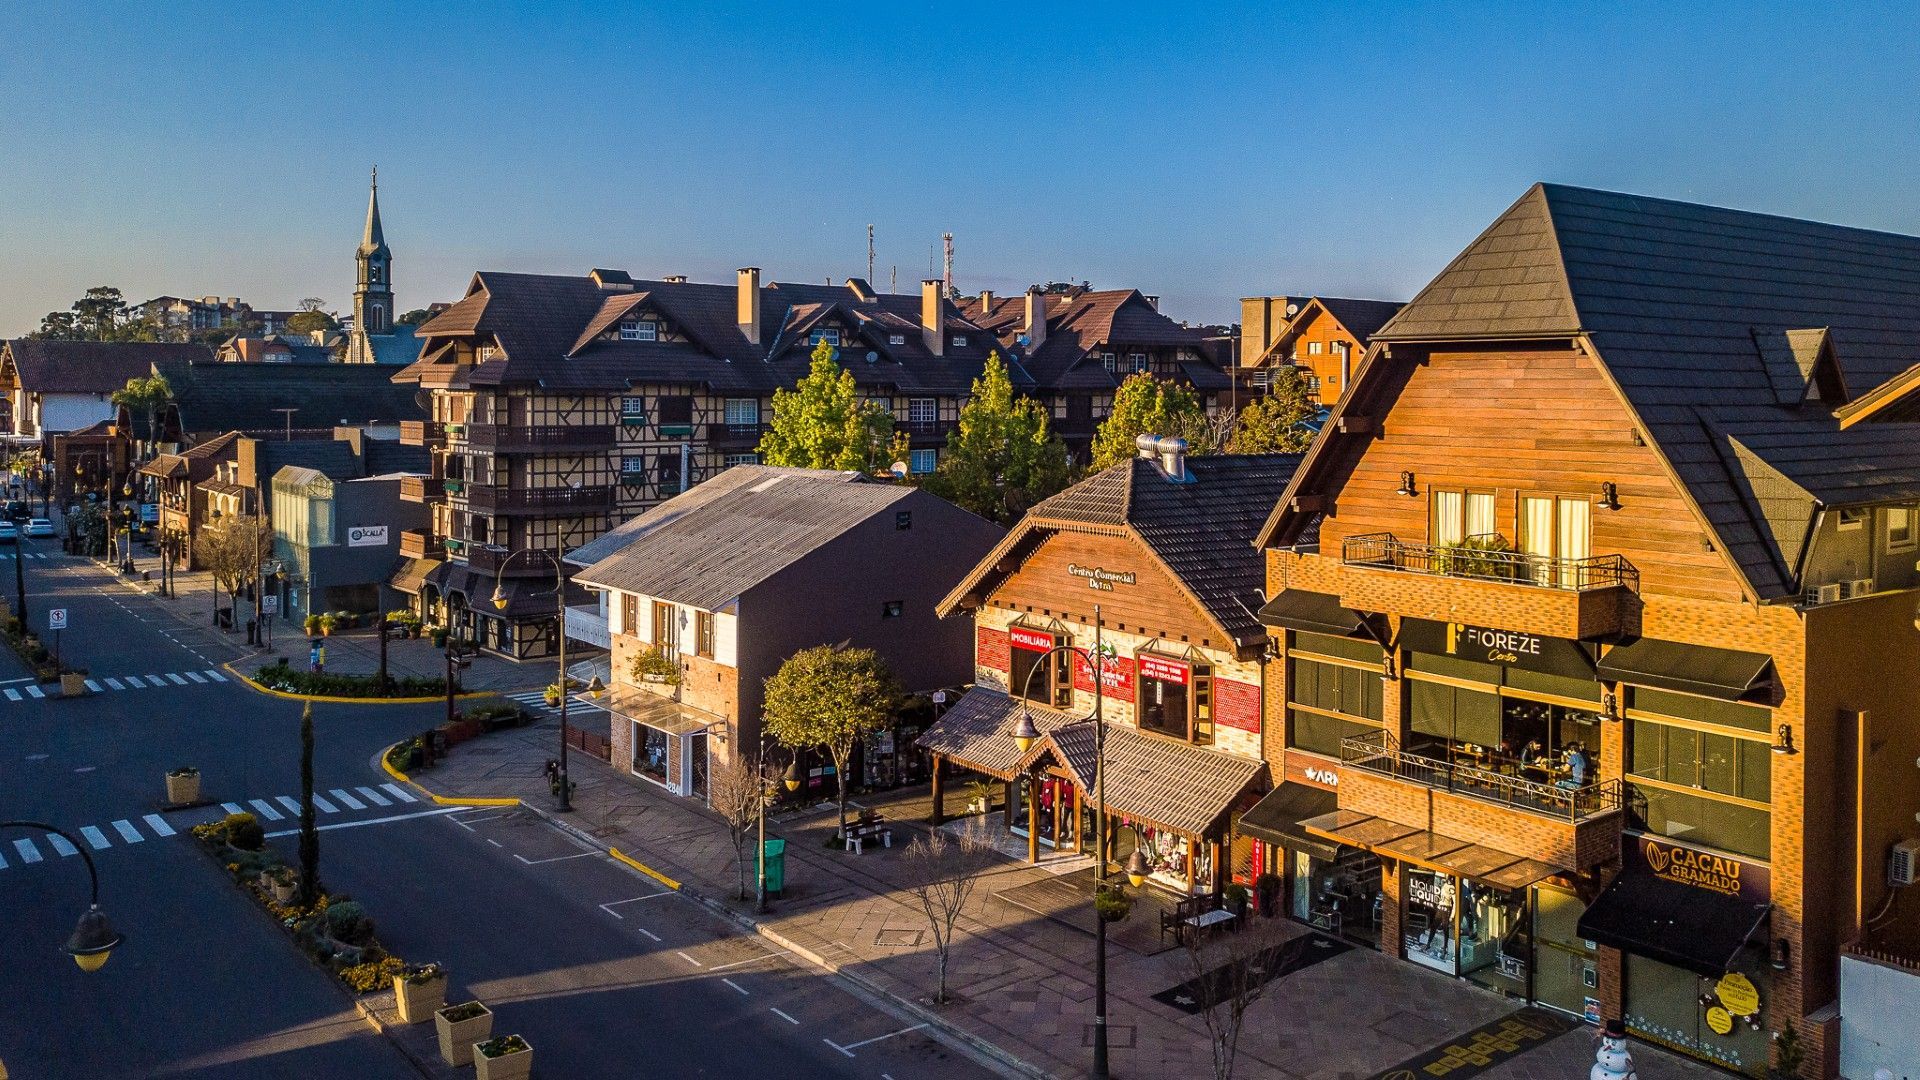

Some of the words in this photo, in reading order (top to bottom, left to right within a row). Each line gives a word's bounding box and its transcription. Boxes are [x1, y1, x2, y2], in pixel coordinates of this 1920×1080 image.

[1468, 629, 1540, 654] FIOREZE
[1670, 847, 1741, 879] CACAU
[1409, 878, 1442, 896] LIQUID
[1670, 864, 1741, 892] GRAMADO
[1409, 887, 1443, 905] LIQUID
